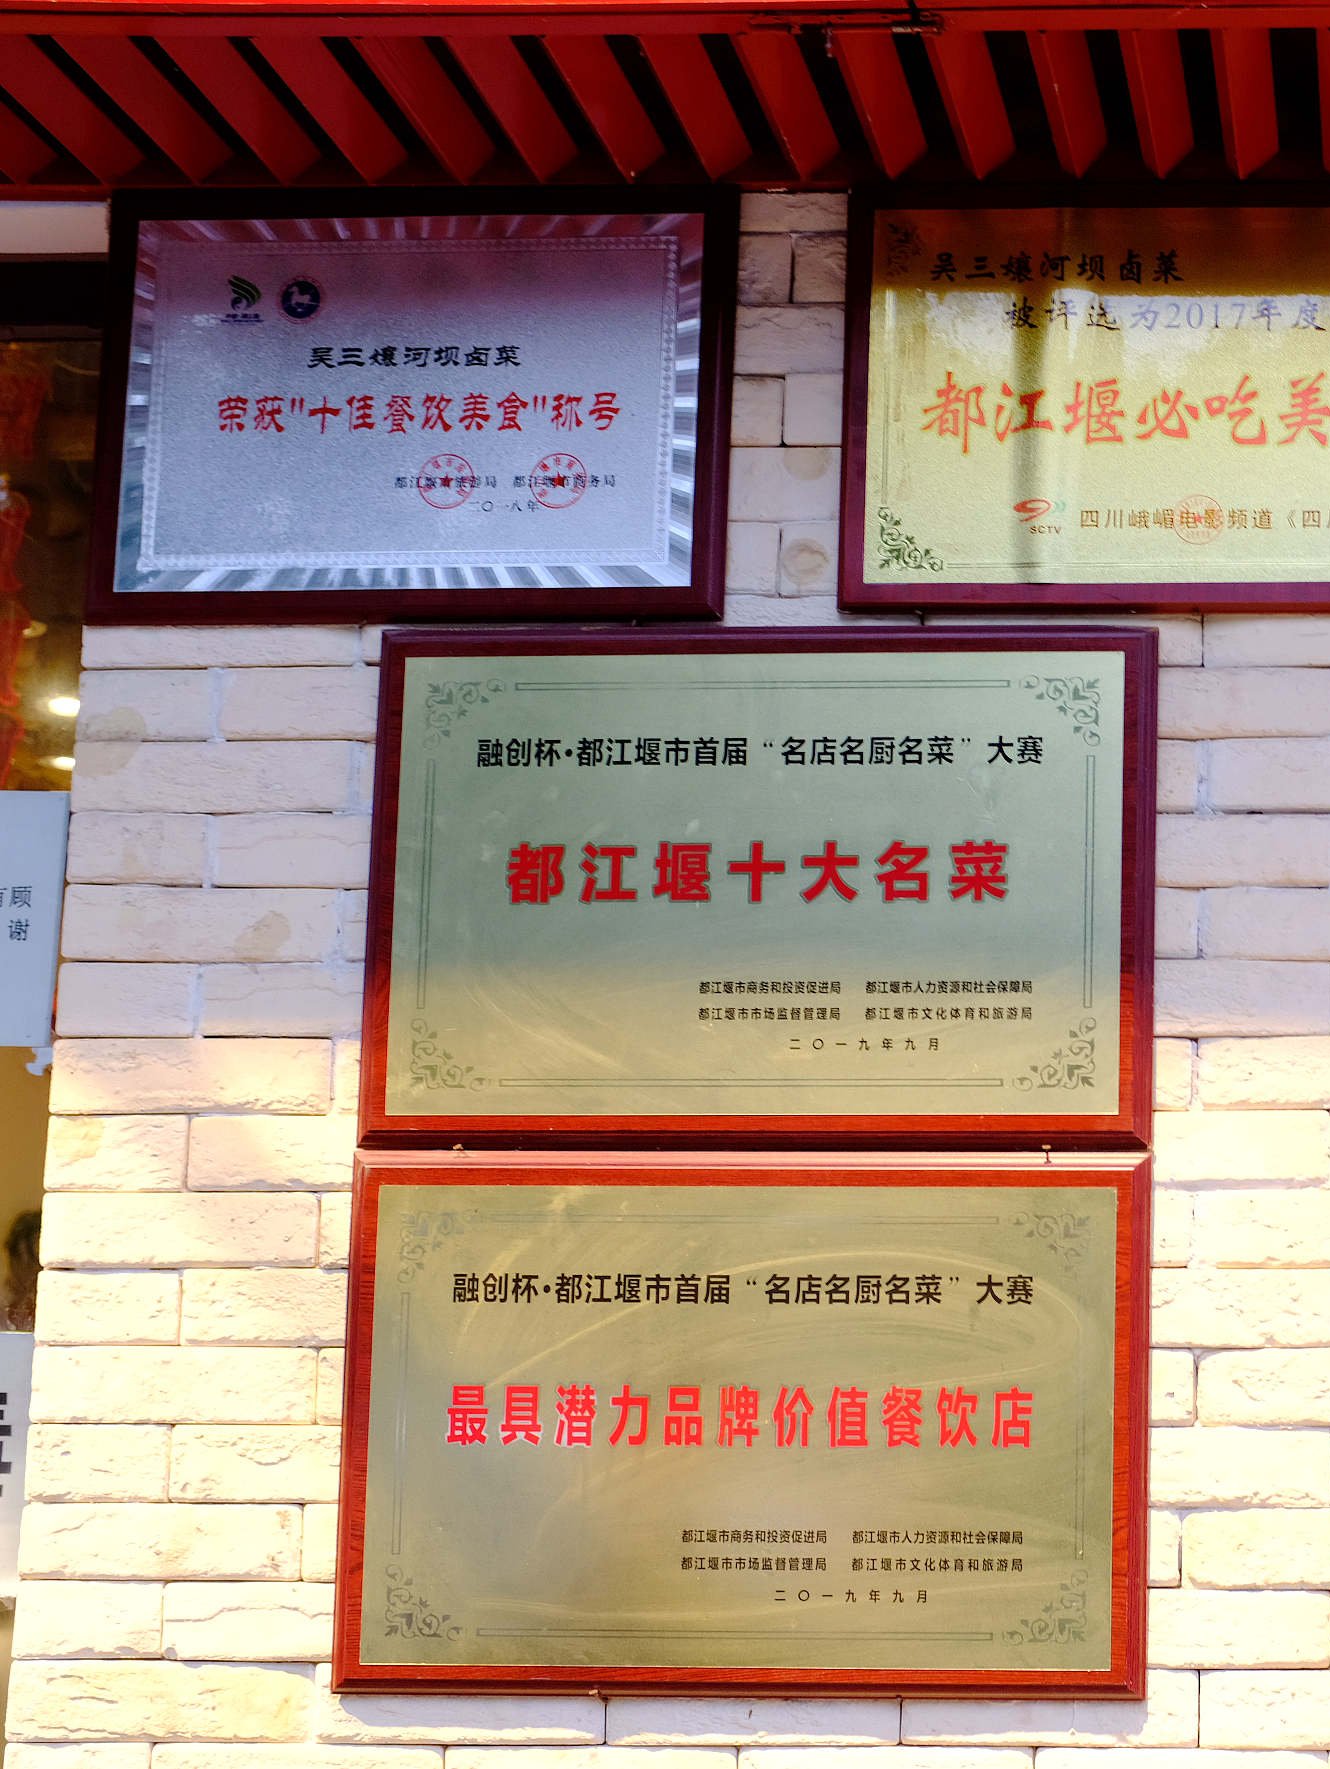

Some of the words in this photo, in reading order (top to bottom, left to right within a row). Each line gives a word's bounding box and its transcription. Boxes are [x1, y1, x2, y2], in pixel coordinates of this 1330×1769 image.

[1004, 296, 1328, 332] 被评选为2017年度
[394, 475, 497, 489] 都江堰旅游局
[1029, 525, 1062, 536] SCTV
[507, 839, 1010, 904] 都江堰十大名菜
[699, 980, 841, 995] 都江堰市商务和投资促进局
[865, 980, 1033, 995] 都江堰市人力资源和社会保障局
[698, 1007, 840, 1021] 都江堰市市场监督管理局
[865, 1007, 1033, 1021] 都江堰市文化体育和旅游局
[445, 1383, 1036, 1449] 最具潜力品牌价值餐饮店
[681, 1529, 827, 1545] 都江堰市商务和投资促进局
[851, 1529, 1023, 1546] 都江堰市人力资源和社会保障局
[681, 1556, 827, 1572] 都江堰市市场监督管理局
[851, 1556, 1023, 1573] 都江堰市文化体育和旅游局
